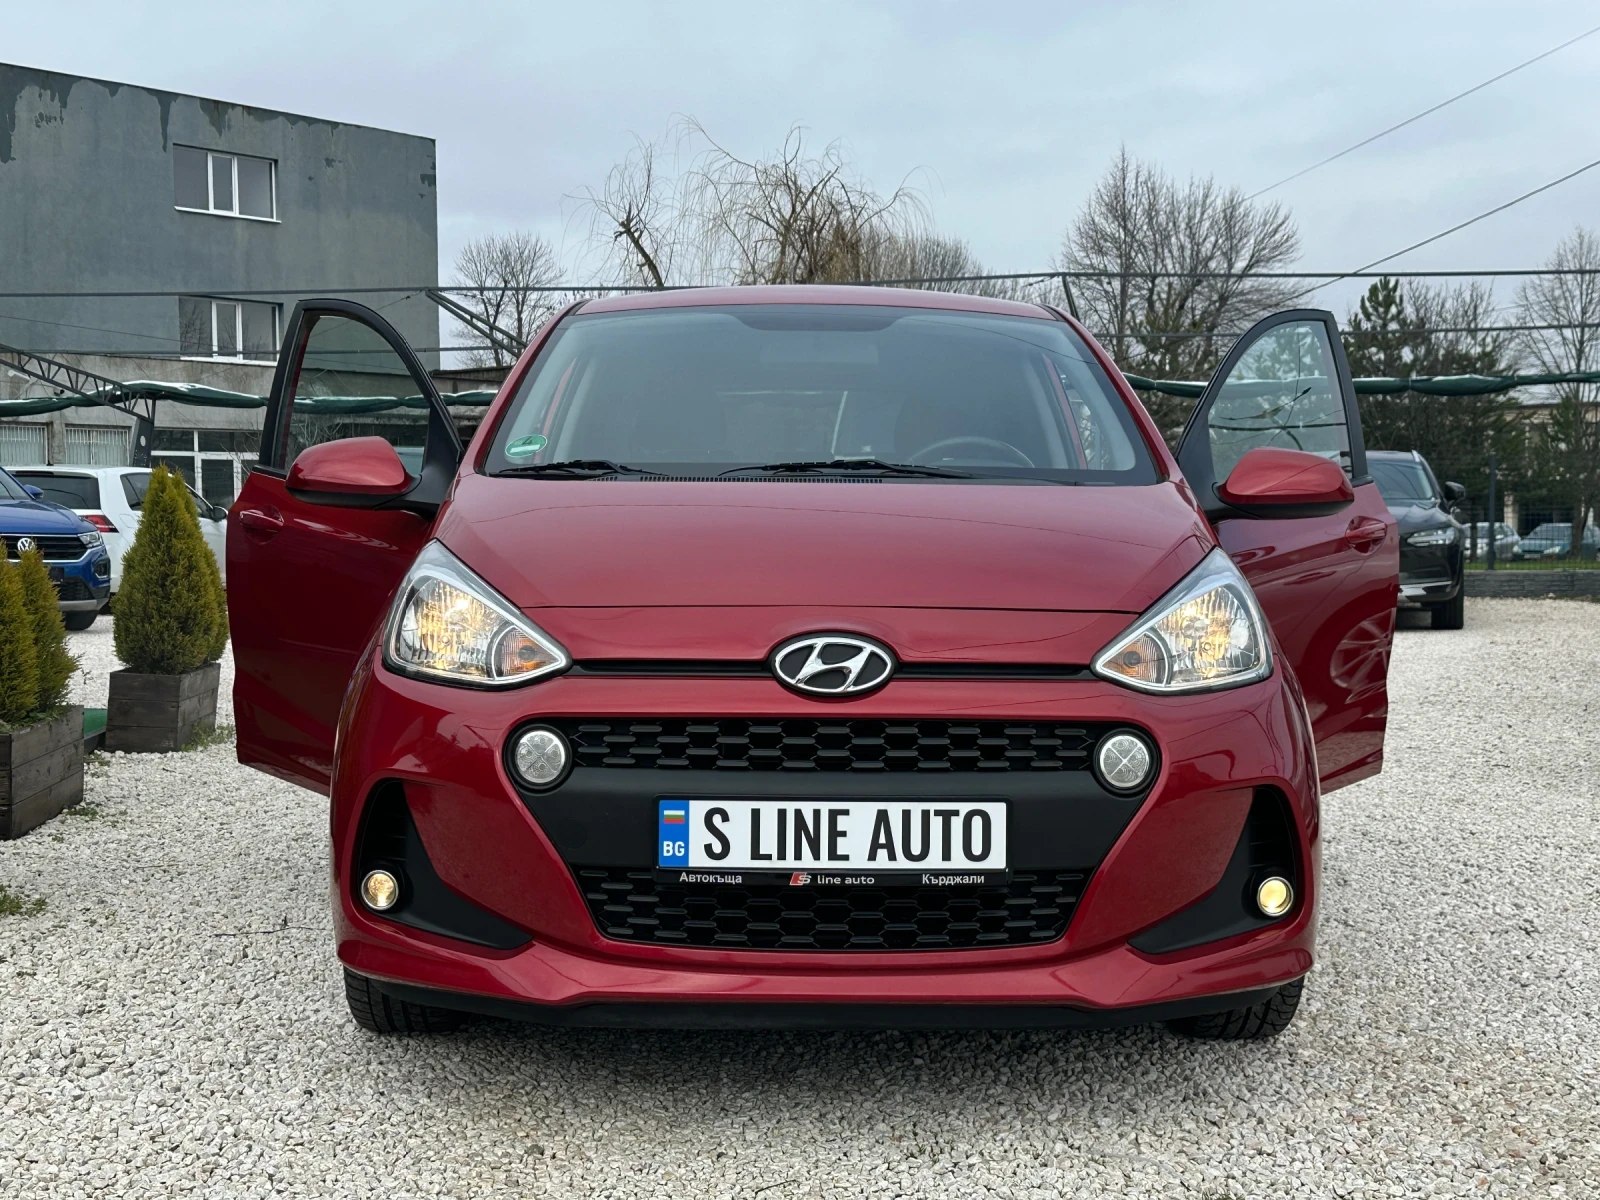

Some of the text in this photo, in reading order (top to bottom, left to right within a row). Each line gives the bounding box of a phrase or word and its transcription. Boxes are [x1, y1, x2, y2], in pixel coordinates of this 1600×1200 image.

[703, 807, 992, 862] S LINE AUTO
[663, 841, 685, 857] BG
[679, 872, 742, 884] Автокъща
[817, 875, 842, 884] line
[845, 876, 875, 885] auto
[922, 874, 985, 886] Кърджали
